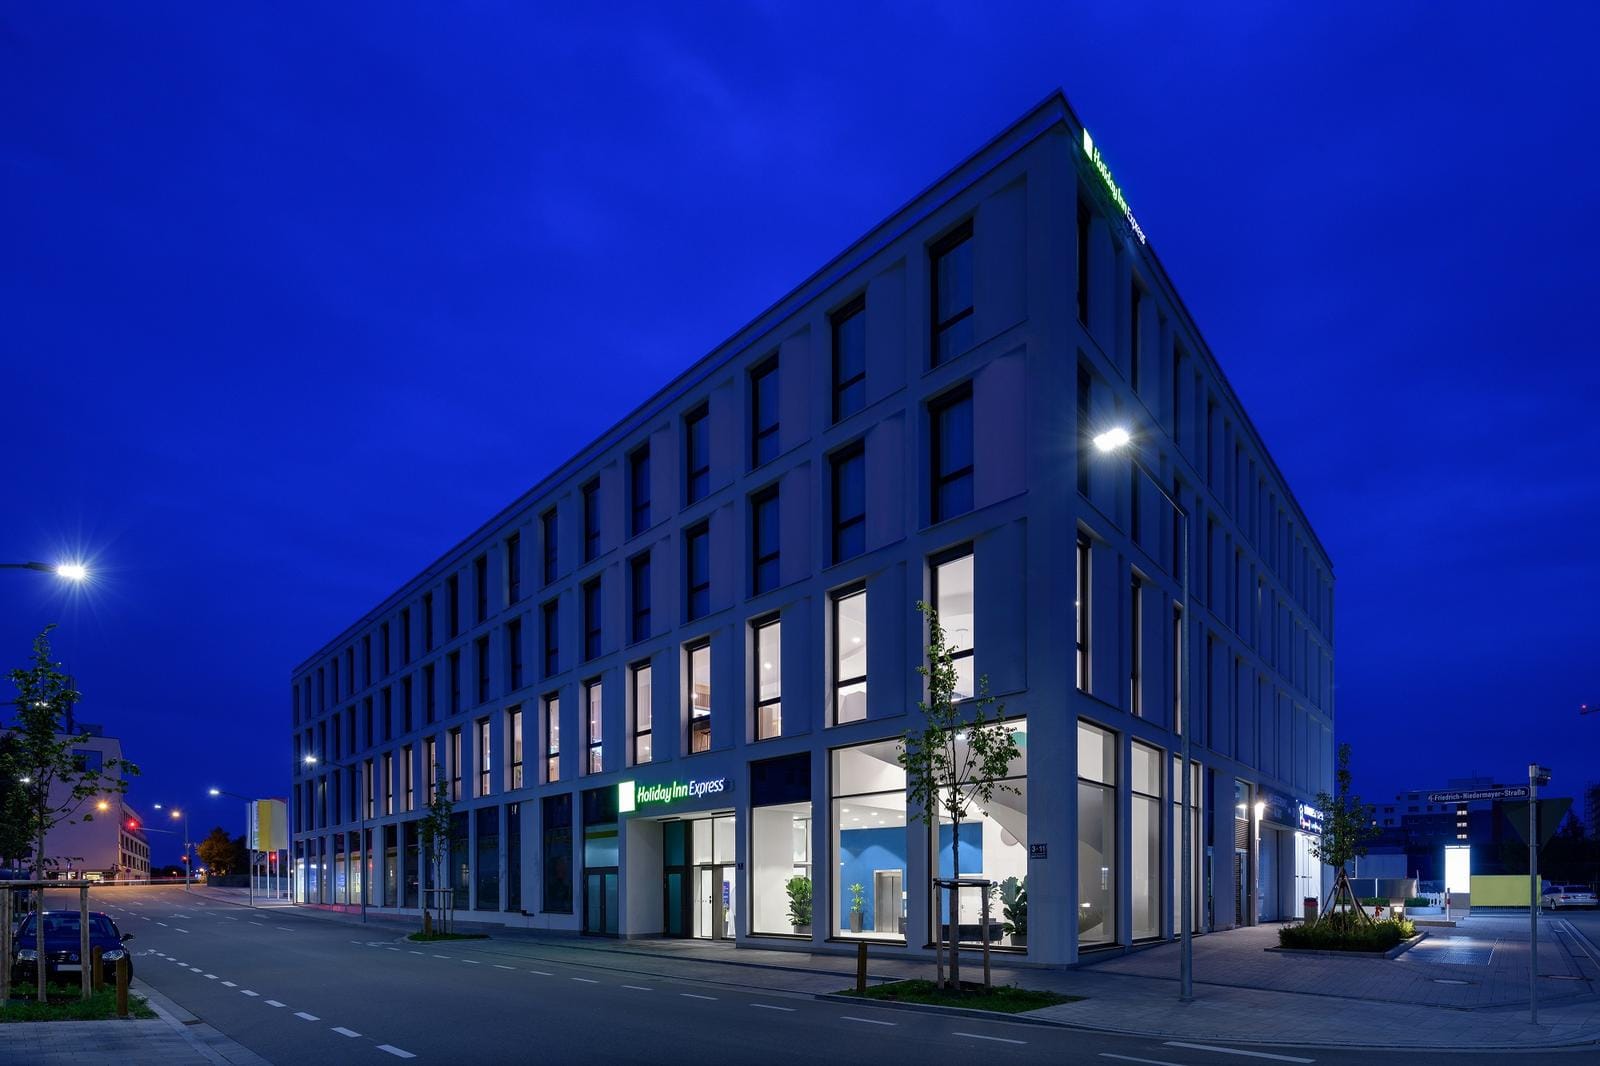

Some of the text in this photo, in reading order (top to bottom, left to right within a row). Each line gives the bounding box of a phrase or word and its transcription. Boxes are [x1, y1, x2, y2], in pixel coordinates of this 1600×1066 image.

[1094, 147, 1146, 244] Holiday Inn Express
[637, 779, 724, 803] Holiday Inn Express
[1434, 789, 1525, 801] Friedrich-Niedermayer-Straße
